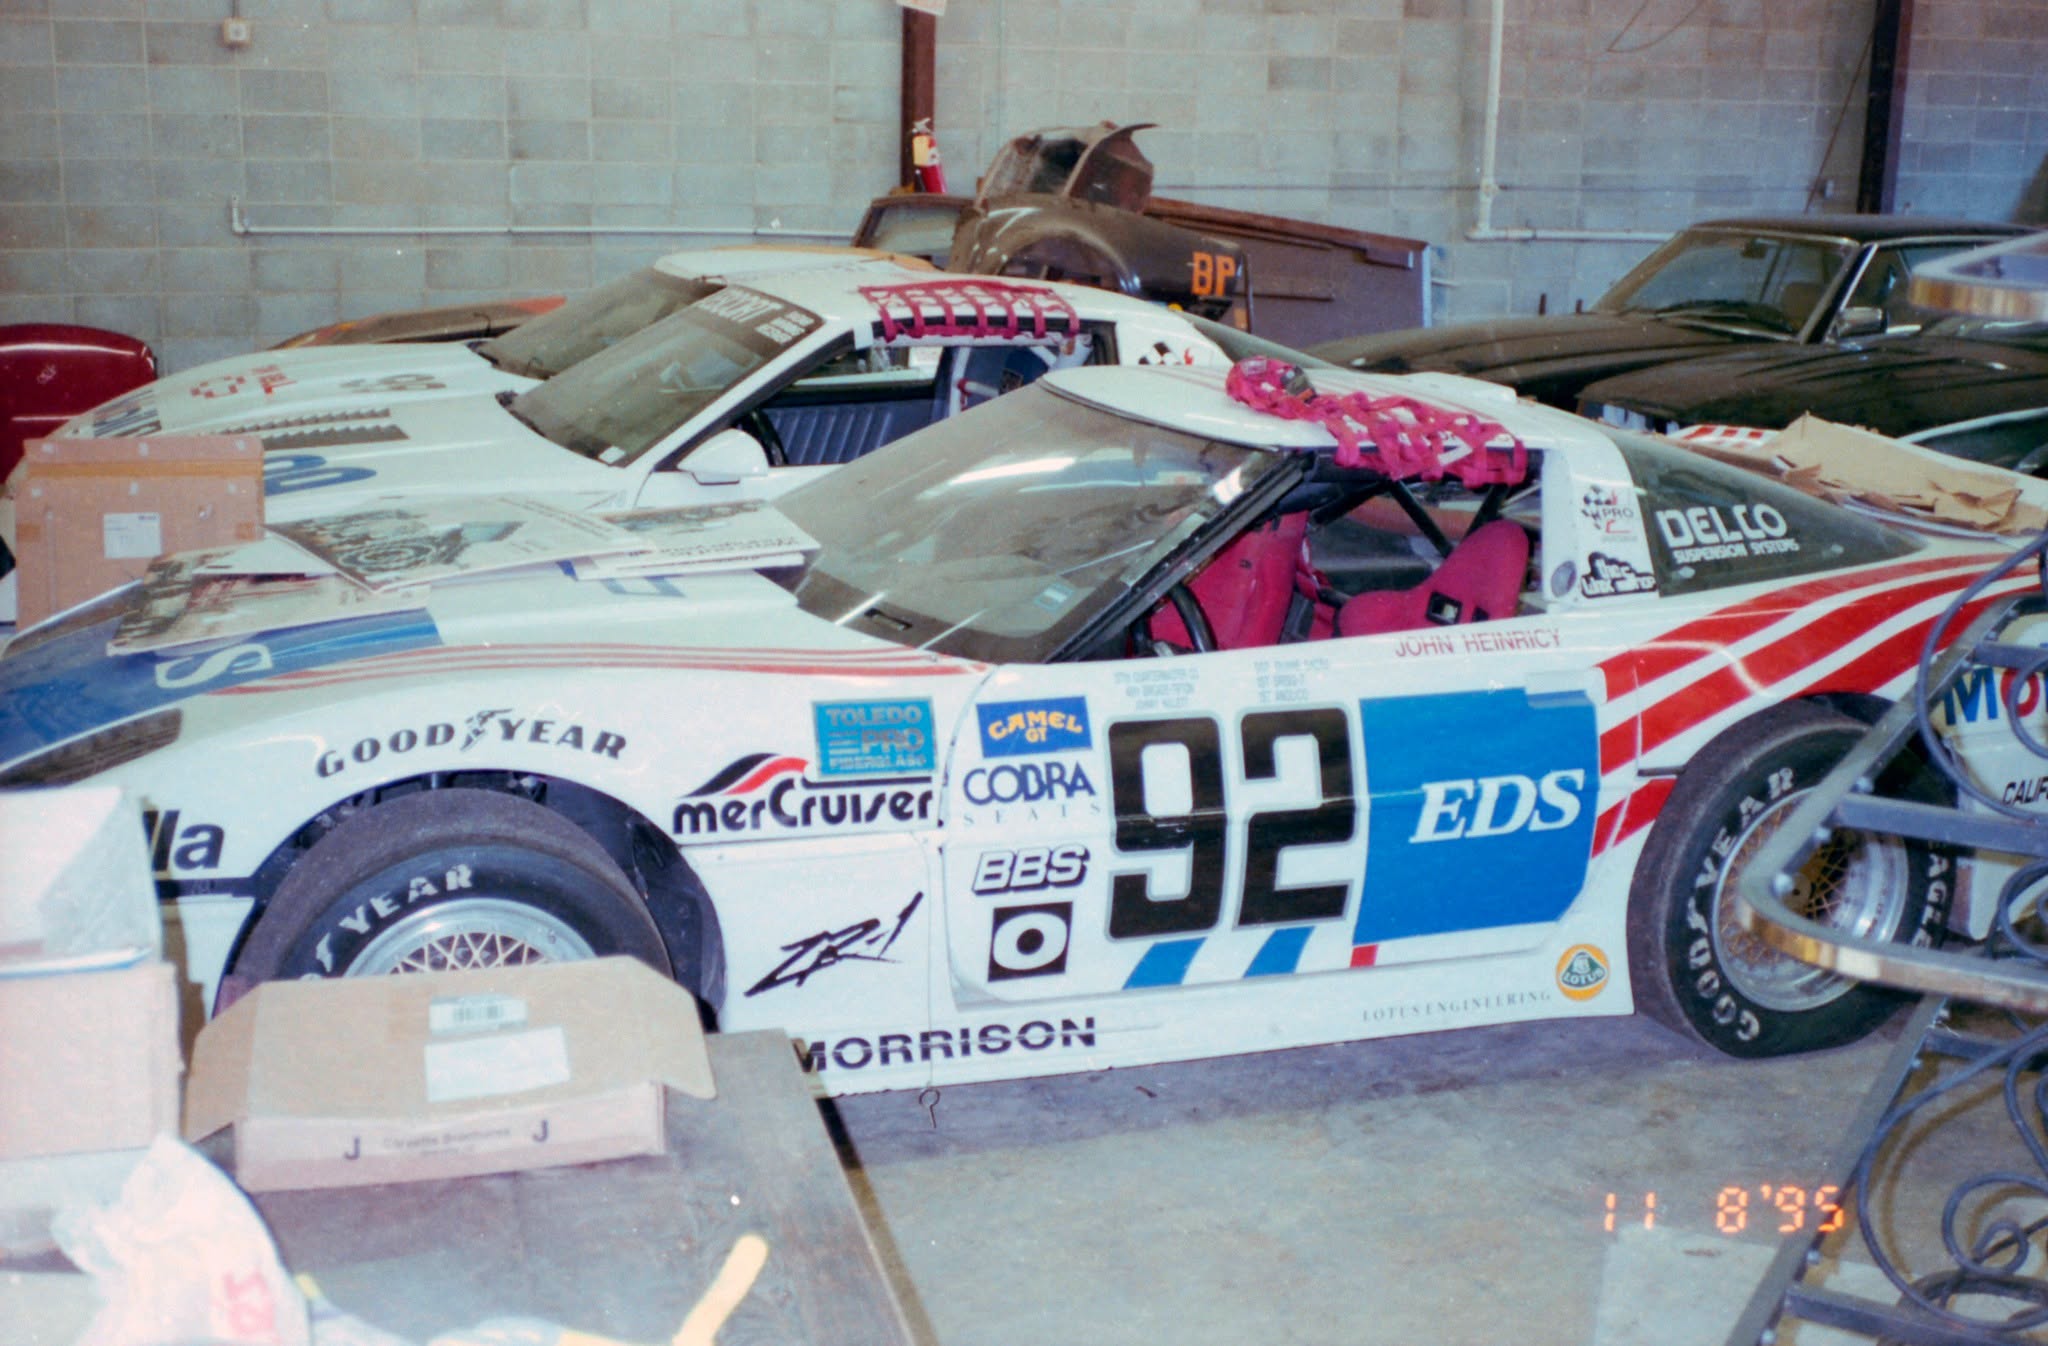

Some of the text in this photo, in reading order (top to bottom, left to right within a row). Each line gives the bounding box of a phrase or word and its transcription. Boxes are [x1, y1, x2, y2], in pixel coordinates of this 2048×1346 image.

[1191, 251, 1237, 297] BP
[1655, 503, 1788, 548] DELCO
[1672, 538, 1801, 564] SUSPENSION SYSTEMS
[1395, 627, 1562, 657] JOHN HEINRICY
[826, 705, 922, 726] TOLEDO
[988, 710, 1084, 740] CAMEL
[862, 727, 925, 754] PRO
[1025, 727, 1048, 743] GT
[963, 760, 1096, 806] COBRA
[673, 778, 933, 834] merCruiser
[1408, 768, 1585, 844] EDS
[1106, 705, 1357, 941] 92
[971, 844, 1091, 896] BBS
[1563, 965, 1607, 986] LOTUS
[1362, 990, 1551, 1023] LOTUS ENGINEERING
